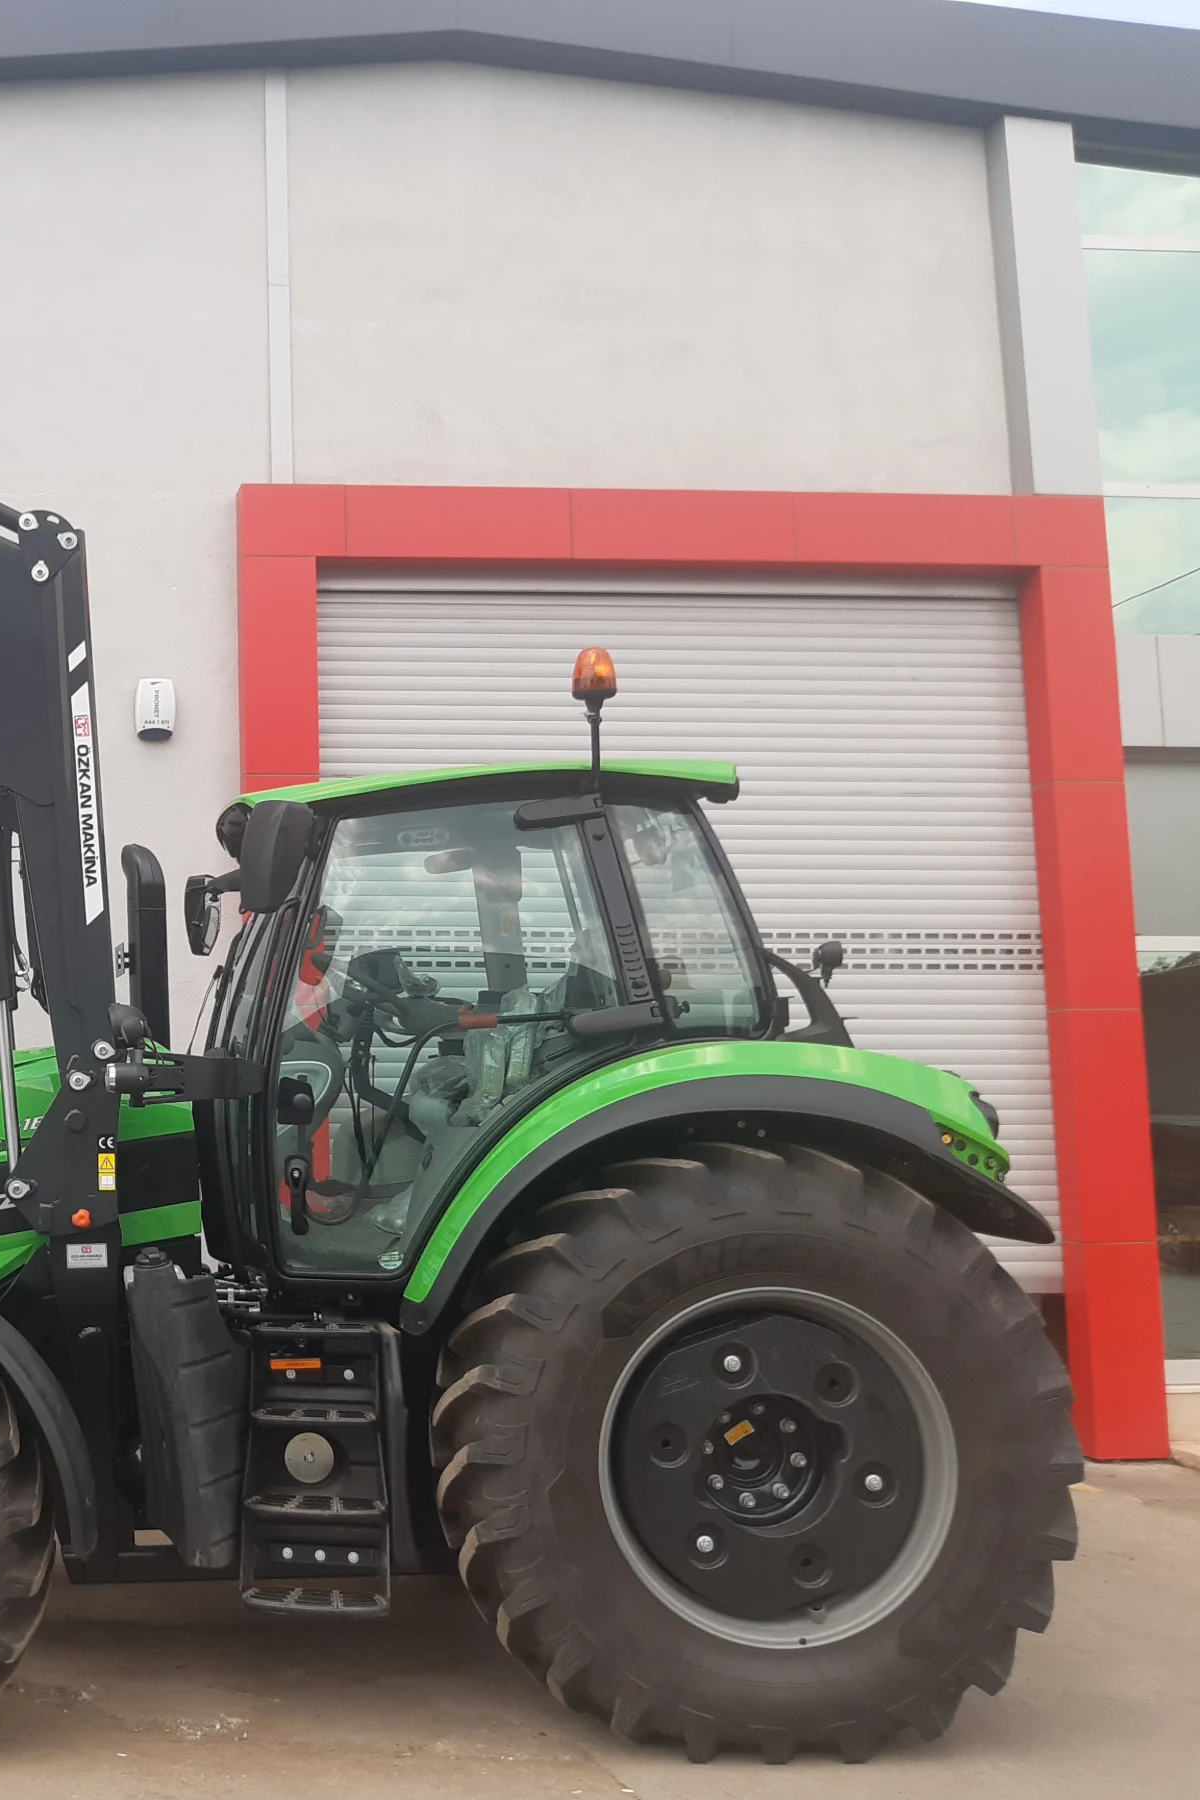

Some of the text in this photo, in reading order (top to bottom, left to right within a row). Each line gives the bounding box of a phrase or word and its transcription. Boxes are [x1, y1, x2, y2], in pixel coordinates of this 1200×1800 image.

[77, 744, 99, 888] ÖZKAN MAKİNA
[98, 1136, 115, 1149] CE
